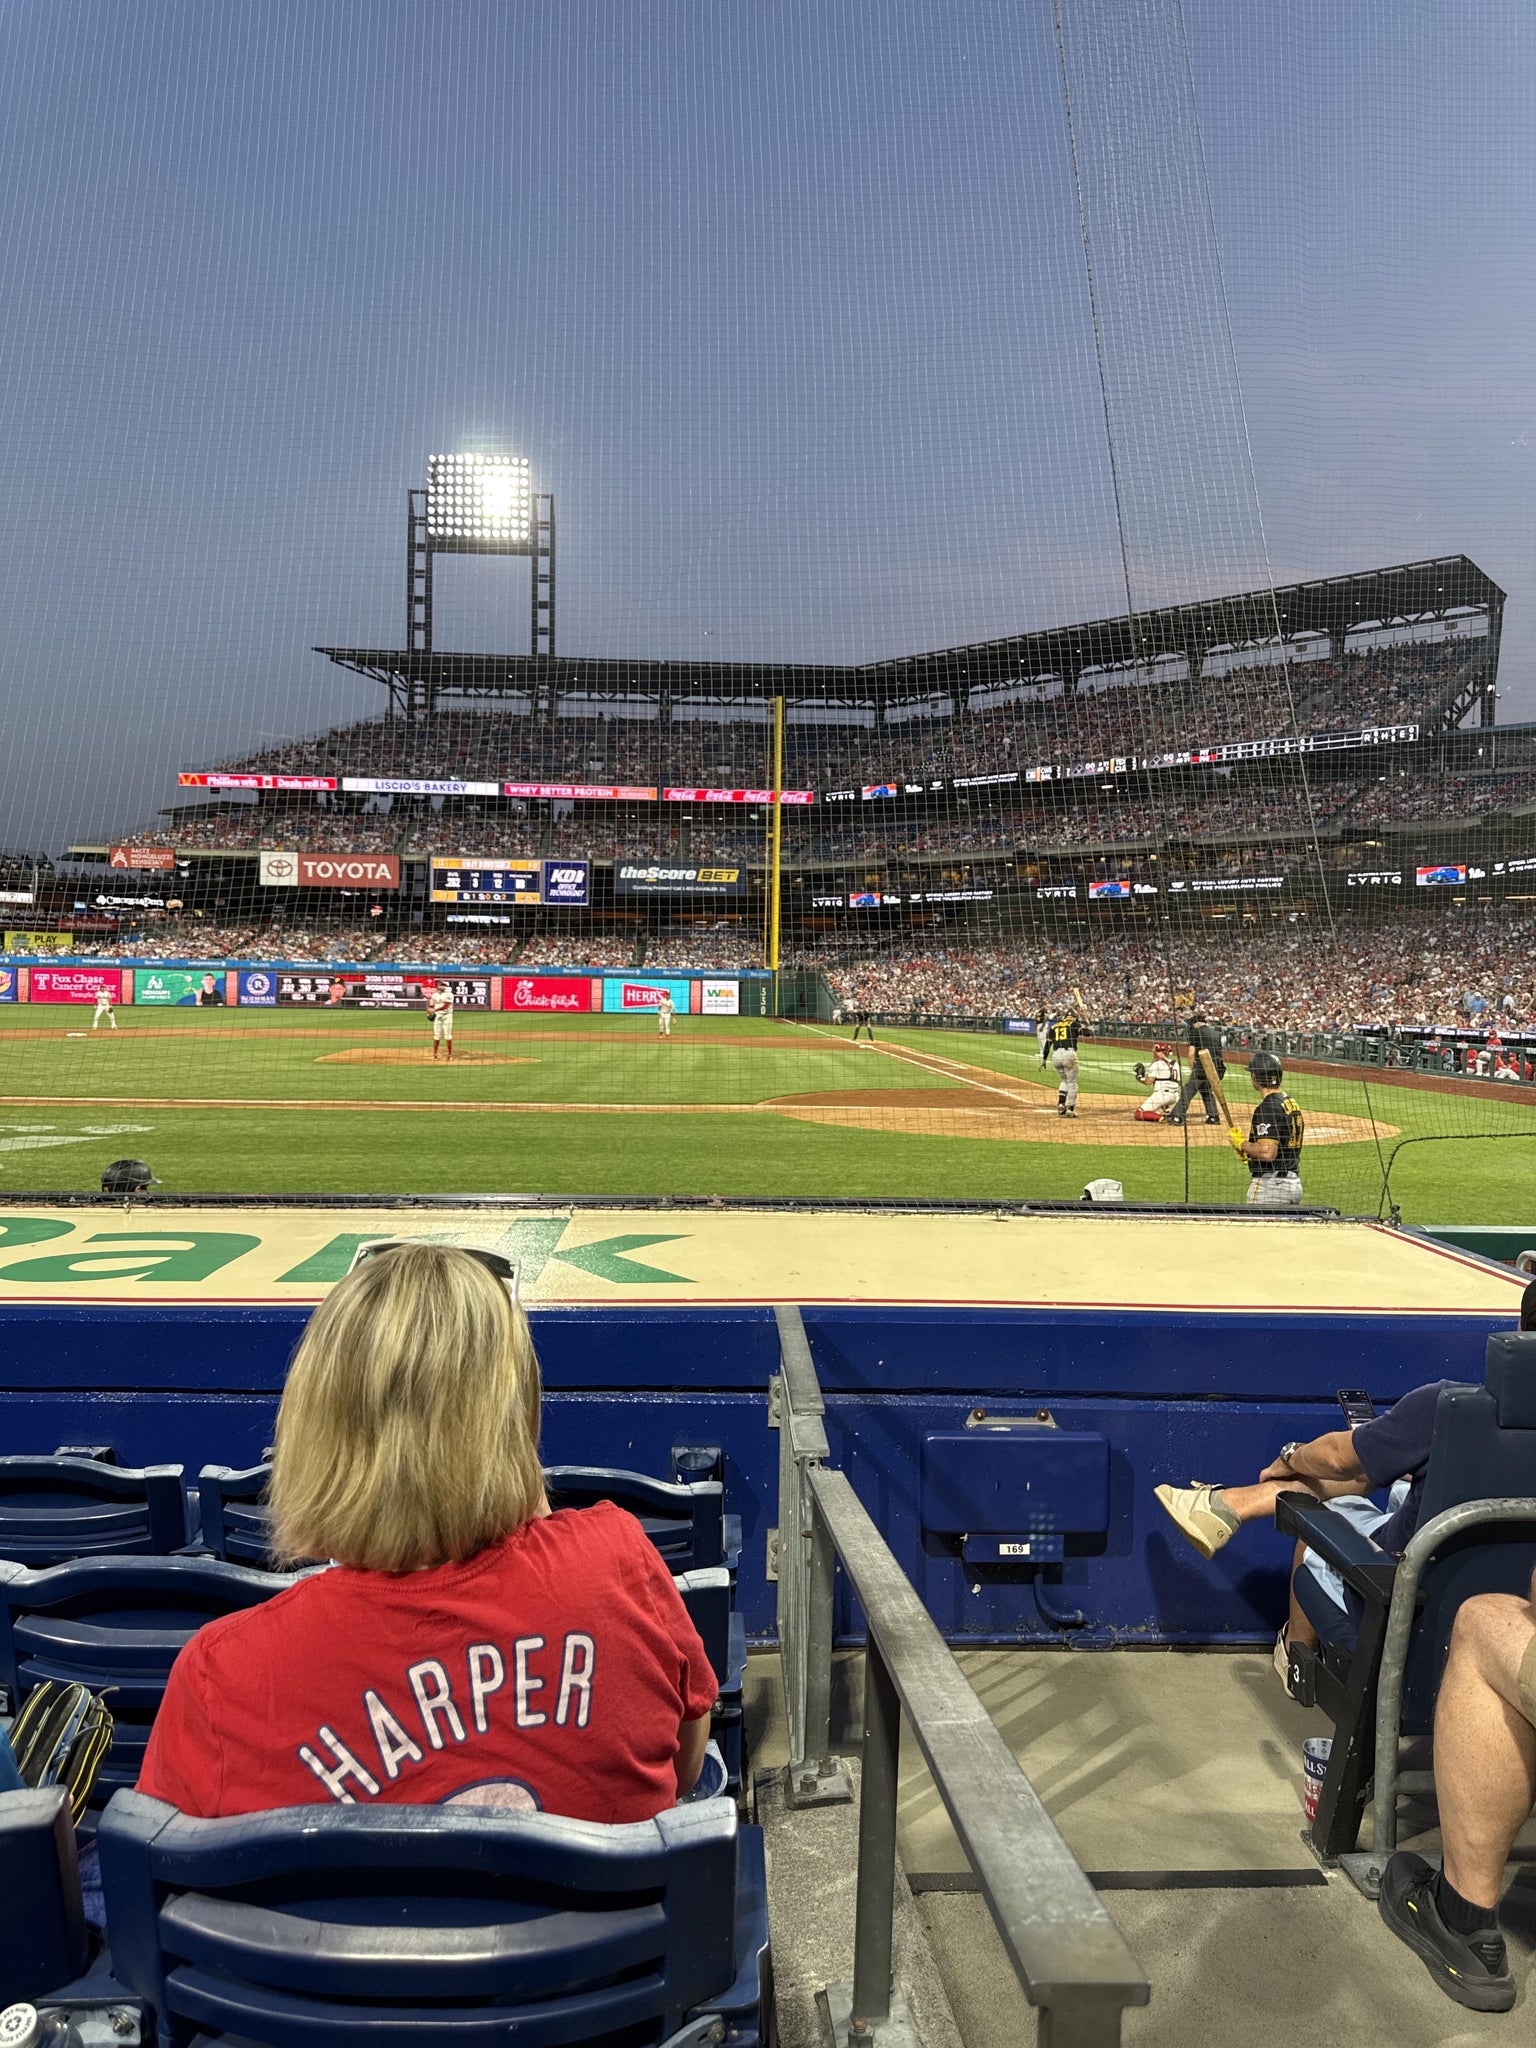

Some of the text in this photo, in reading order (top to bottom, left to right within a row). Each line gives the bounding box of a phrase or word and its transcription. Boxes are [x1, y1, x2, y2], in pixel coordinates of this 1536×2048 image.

[206, 776, 329, 788] Phillies win Deals roll in
[375, 781, 467, 792] LISCIO'S BAKERY
[510, 786, 538, 795] WHEY
[540, 787, 573, 796] BETTER
[574, 787, 613, 797] PROTEIN
[826, 794, 855, 802] LYRIQ
[303, 861, 392, 880] TOYOTA
[551, 869, 585, 883] KDI
[620, 866, 735, 880] theScore BET
[1347, 877, 1402, 885] LYRIQ
[550, 889, 585, 897] TECHNOLOGY
[1037, 890, 1076, 898] LYRIQ
[34, 935, 57, 943] PLAY
[52, 974, 104, 984] Fox Chase
[255, 980, 264, 988] R
[514, 982, 579, 1009] Chick-fil-A
[626, 989, 664, 1003] HERR'S
[707, 989, 735, 997] WM
[1055, 1027, 1067, 1041] 13
[1007, 1545, 1023, 1553] 169
[1293, 1664, 1300, 1683] 3
[297, 1630, 597, 1804] HARPER
